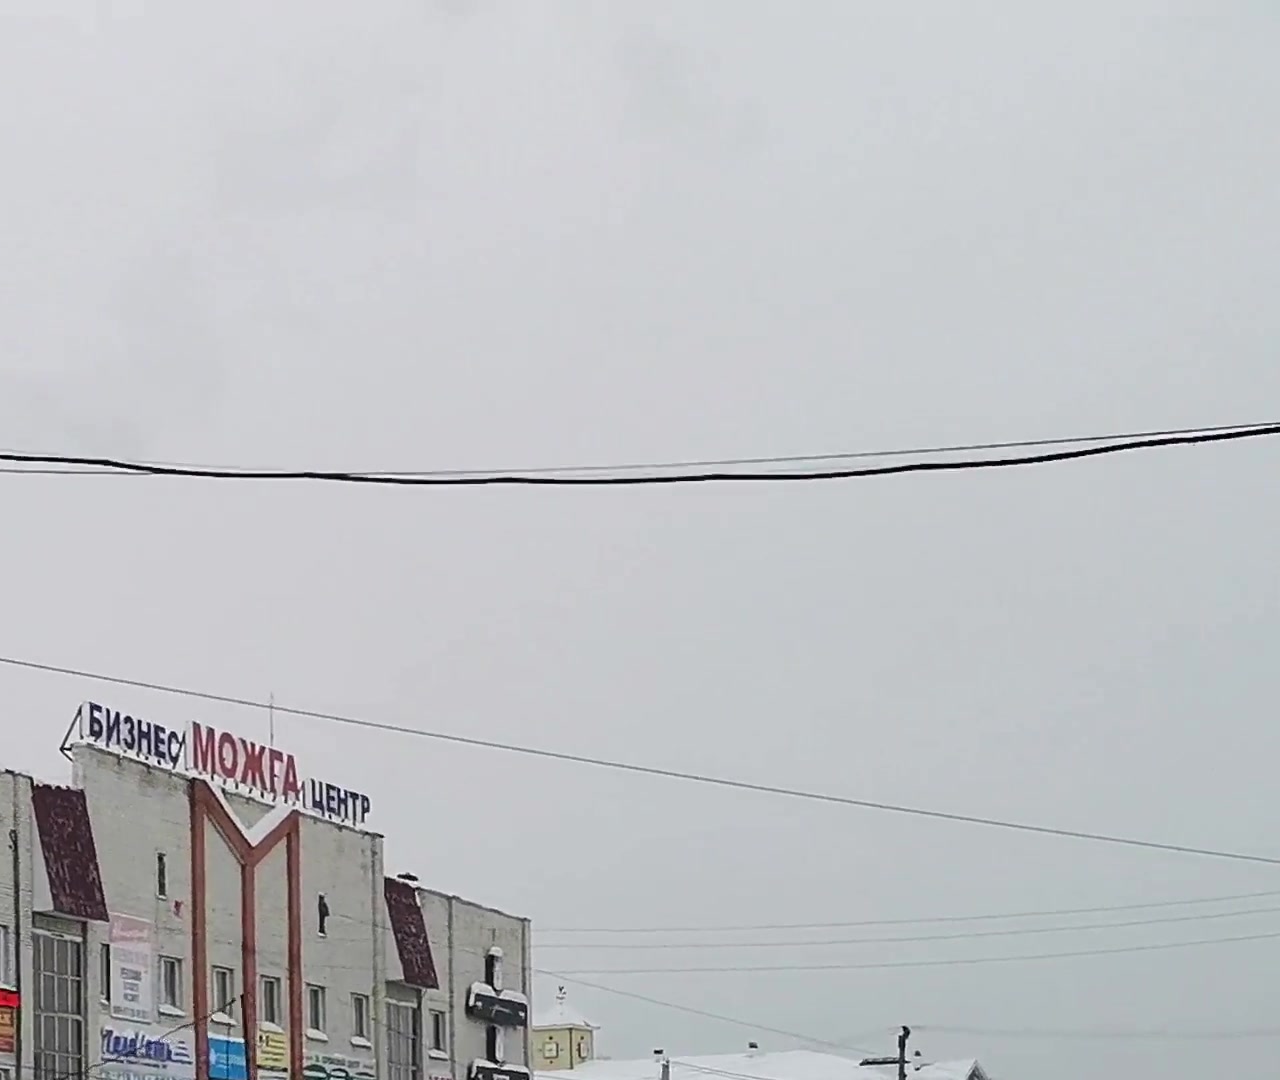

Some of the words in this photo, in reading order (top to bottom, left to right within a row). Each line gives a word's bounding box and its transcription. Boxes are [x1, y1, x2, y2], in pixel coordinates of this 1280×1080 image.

[88, 702, 180, 765] БИЗНЕС
[192, 721, 300, 802] МОЖГА
[311, 779, 371, 823] ЦЕНТР
